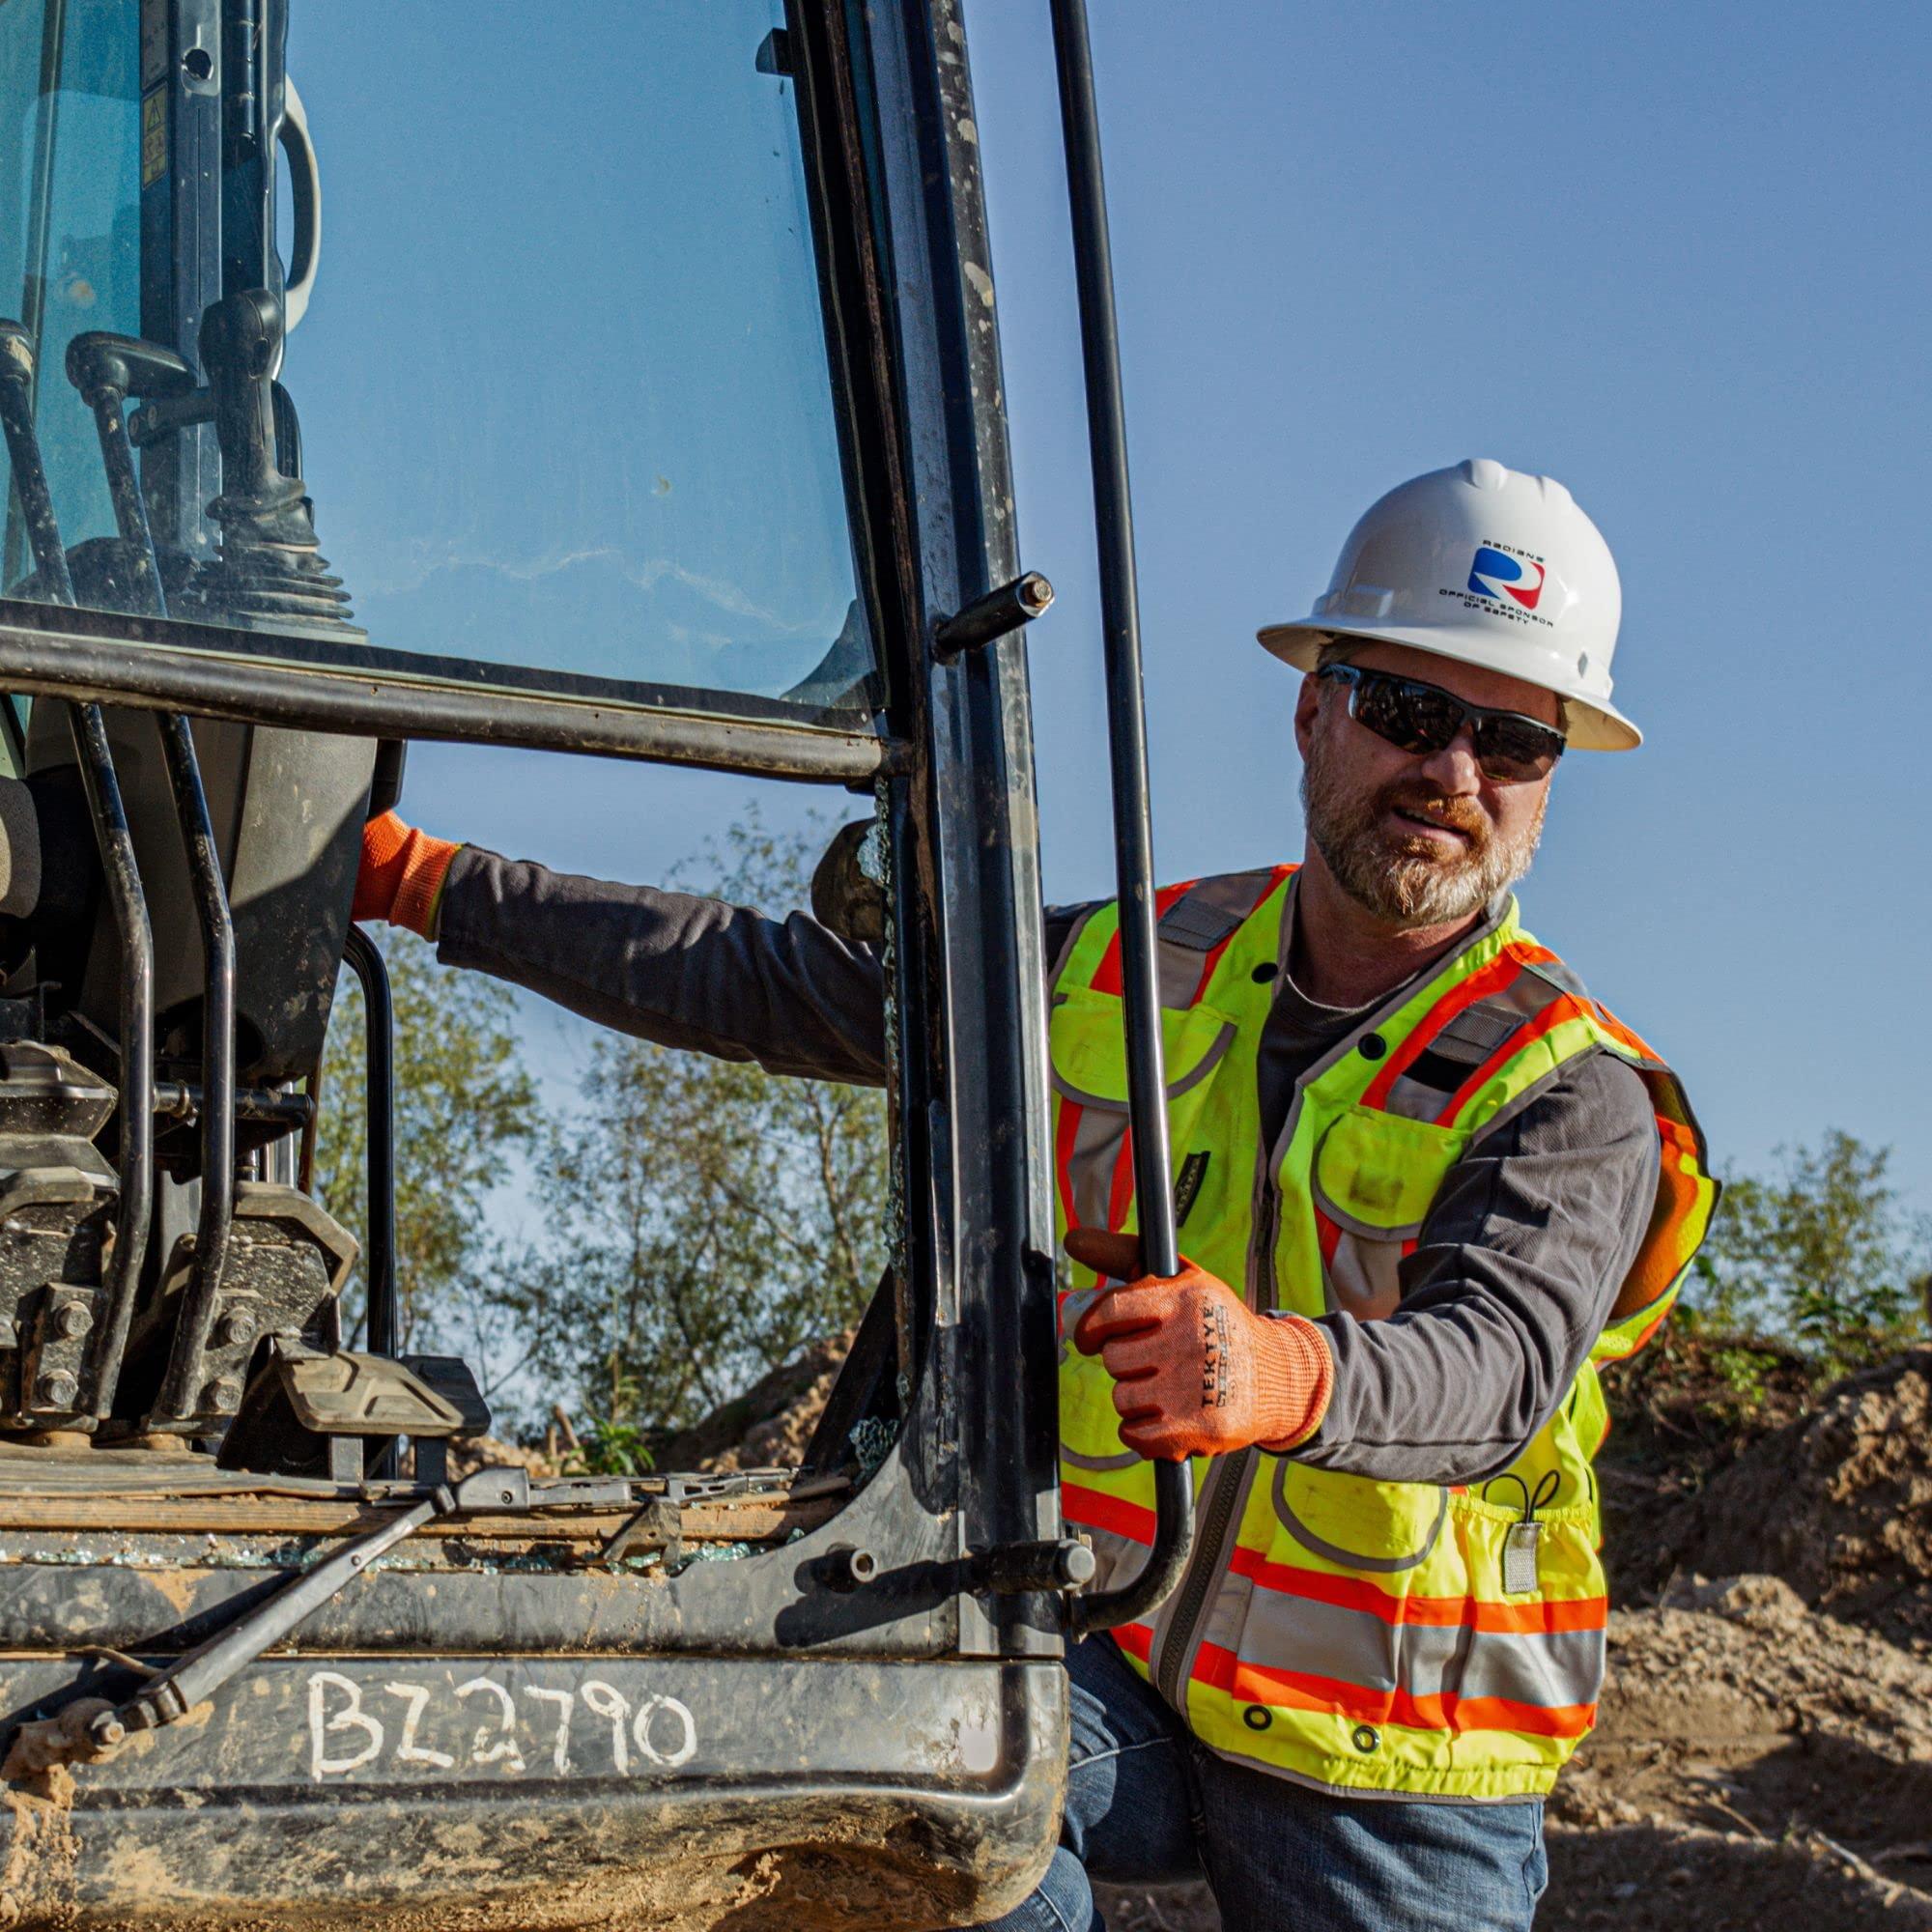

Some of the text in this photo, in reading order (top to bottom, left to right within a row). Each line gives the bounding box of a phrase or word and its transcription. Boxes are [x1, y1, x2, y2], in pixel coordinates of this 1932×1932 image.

[1438, 588, 1553, 627] OFFICIAL SPONSOR
[1463, 601, 1529, 625] OF SAFETY
[308, 1671, 697, 1783] BZ2790
